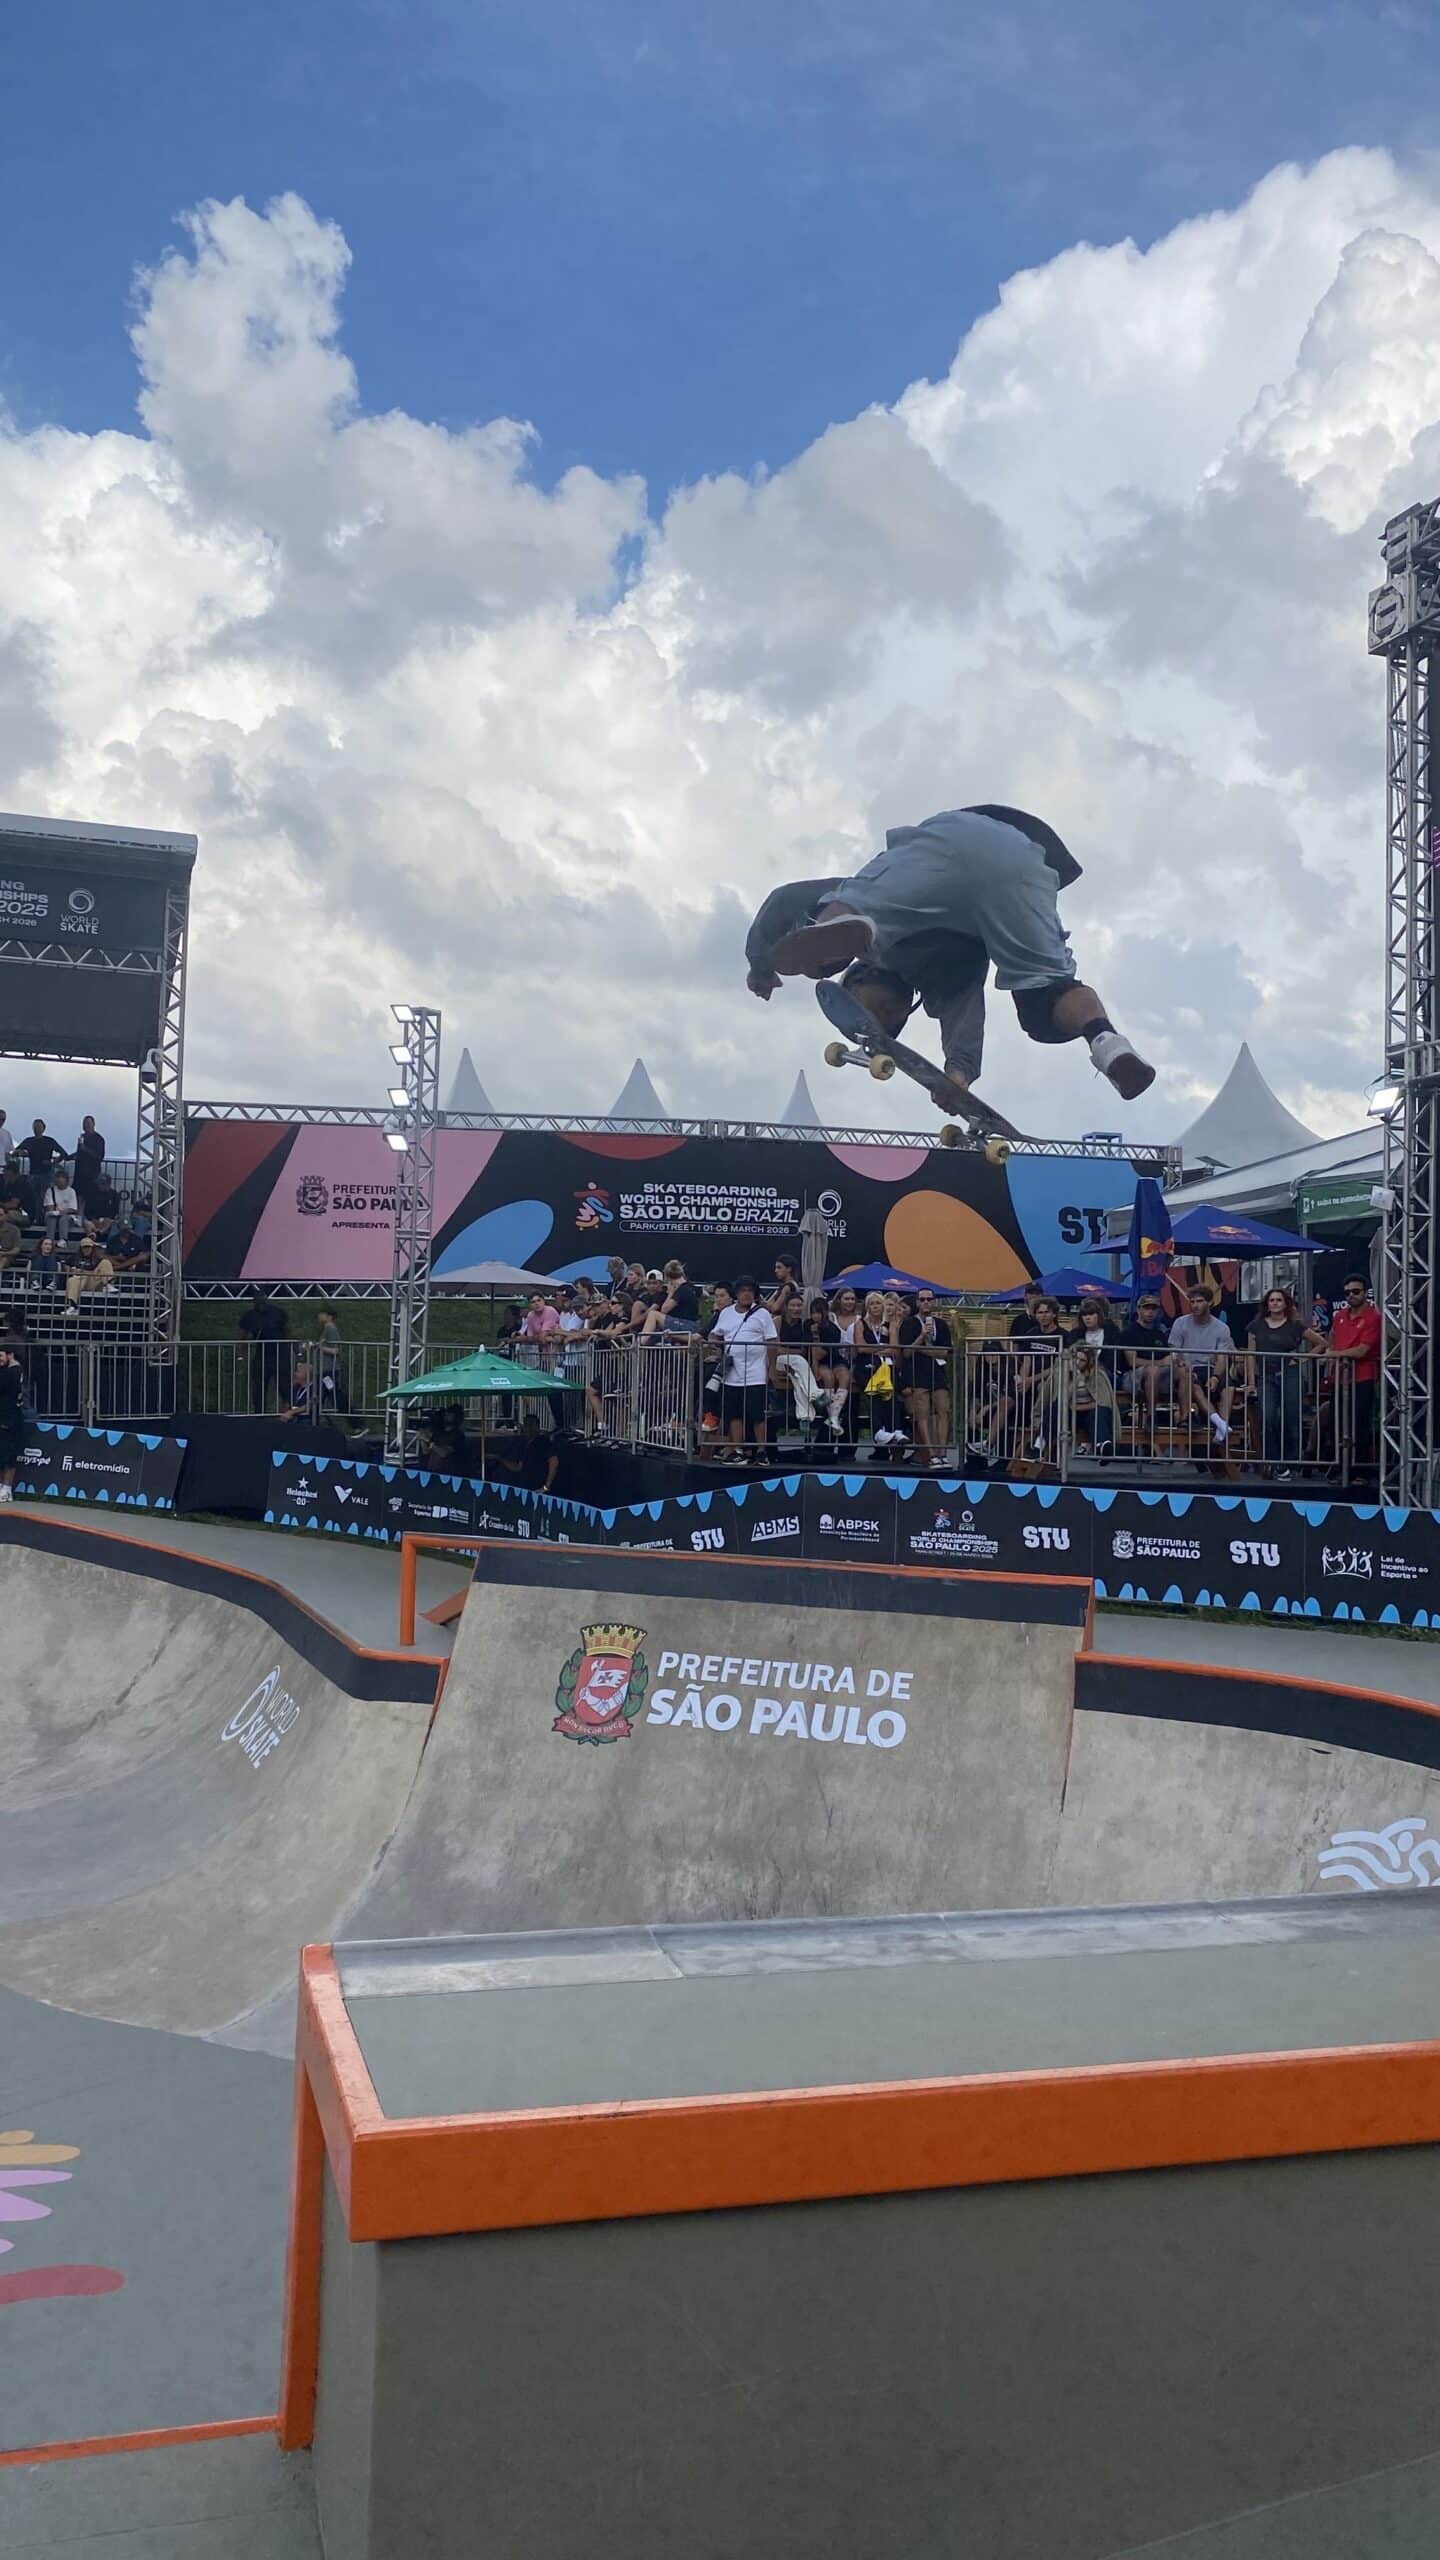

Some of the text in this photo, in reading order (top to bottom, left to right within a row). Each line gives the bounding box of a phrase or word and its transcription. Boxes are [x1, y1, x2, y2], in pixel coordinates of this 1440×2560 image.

[0, 890, 48, 904] SHIPS
[60, 914, 99, 926] WORLD
[60, 921, 99, 935] SKATE
[333, 1184, 400, 1195] PREFEITUR
[643, 1183, 777, 1197] SKATEBOARDING
[332, 1194, 367, 1210] SÃO
[619, 1194, 800, 1209] WORLD CHAMPIONSHIPS
[619, 1204, 799, 1223] SÃO PAULO BRAZIL
[331, 1221, 391, 1230] APRESENTA
[630, 1222, 696, 1231] PARK/STREET
[730, 1225, 764, 1233] MARCH
[766, 1226, 790, 1234] 2026
[1058, 1206, 1107, 1245] ST
[351, 1496, 369, 1506] VALE
[753, 1517, 799, 1538] ABMS
[836, 1519, 880, 1531] ABPSK
[690, 1527, 725, 1551] STU
[910, 1535, 998, 1547] WORLD CHAMPIONSHIPS
[921, 1531, 987, 1540] SKATEBOARDING
[1023, 1526, 1070, 1550] STU
[935, 1542, 971, 1552] PAULO
[972, 1545, 998, 1554] 2025
[1137, 1537, 1200, 1549] PREFEITURA DE
[1136, 1545, 1200, 1559] SÃO PAULO
[1230, 1541, 1280, 1566] STU
[1381, 1563, 1417, 1572] Incentivo
[657, 1652, 914, 1700] PREFEITURA DE
[646, 1684, 907, 1748] SÃO PAULO
